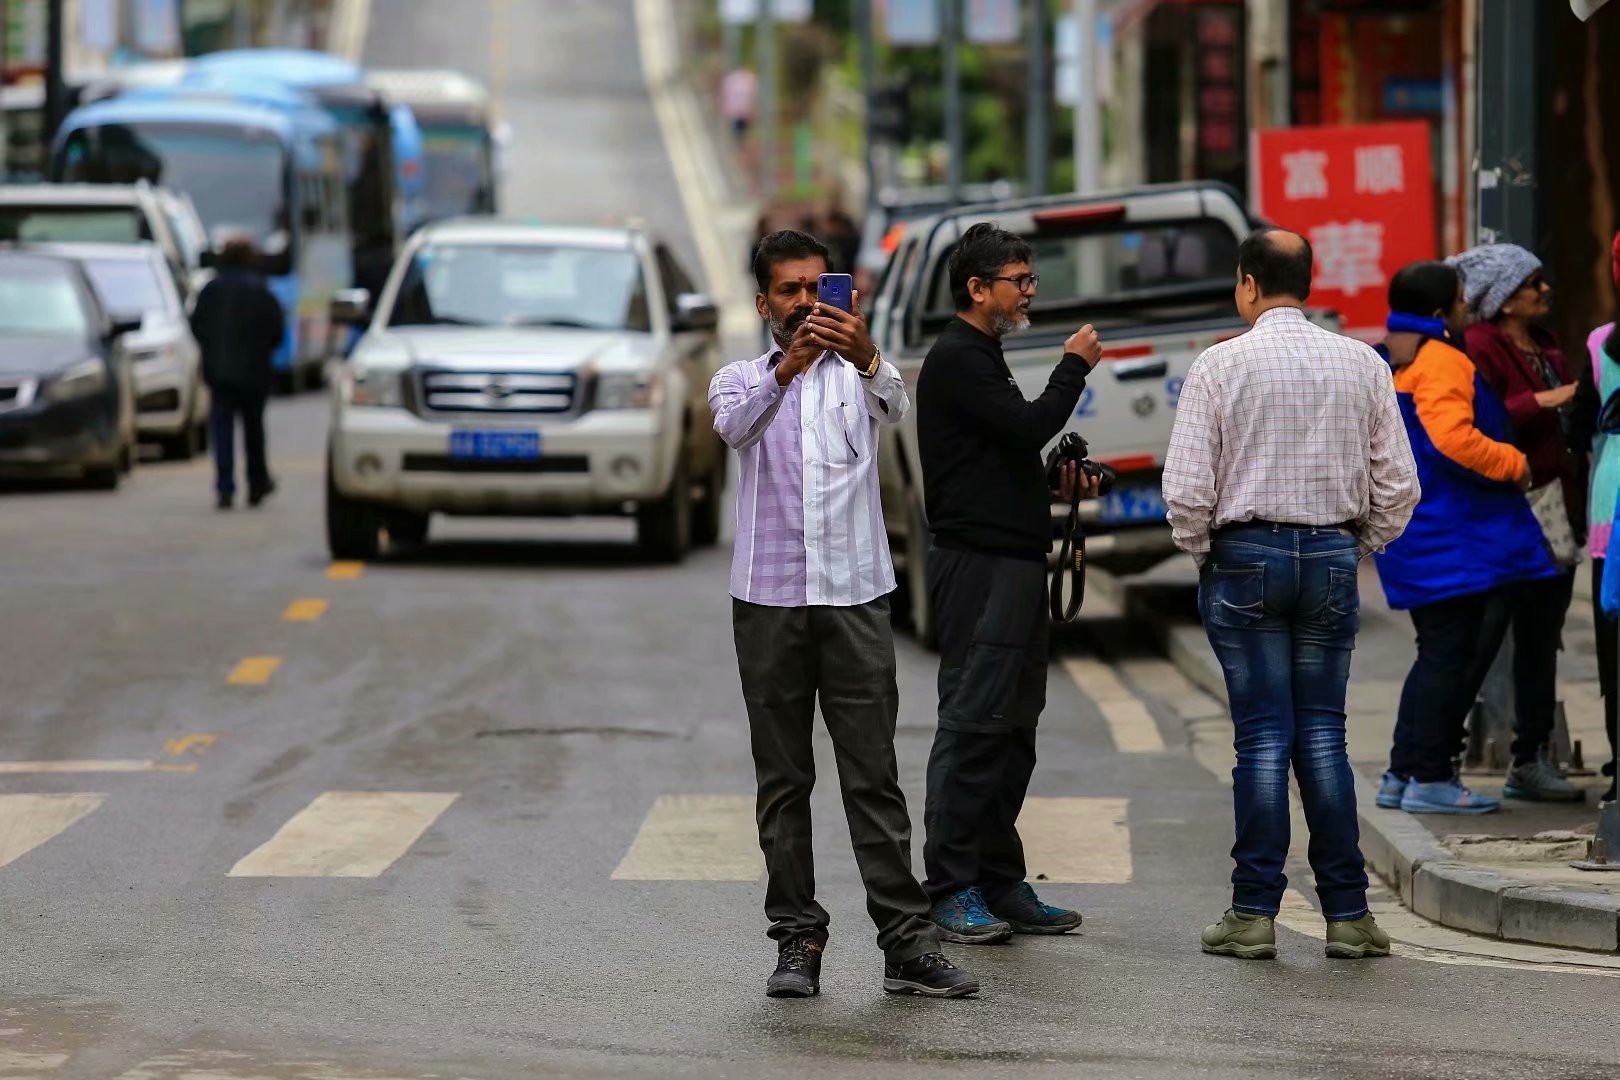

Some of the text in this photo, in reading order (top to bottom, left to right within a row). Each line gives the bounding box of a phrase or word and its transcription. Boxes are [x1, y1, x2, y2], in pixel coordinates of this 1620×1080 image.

[1281, 144, 1405, 200] 富顺
[1076, 386, 1096, 416] 2
[1075, 549, 1083, 571] Nikon
